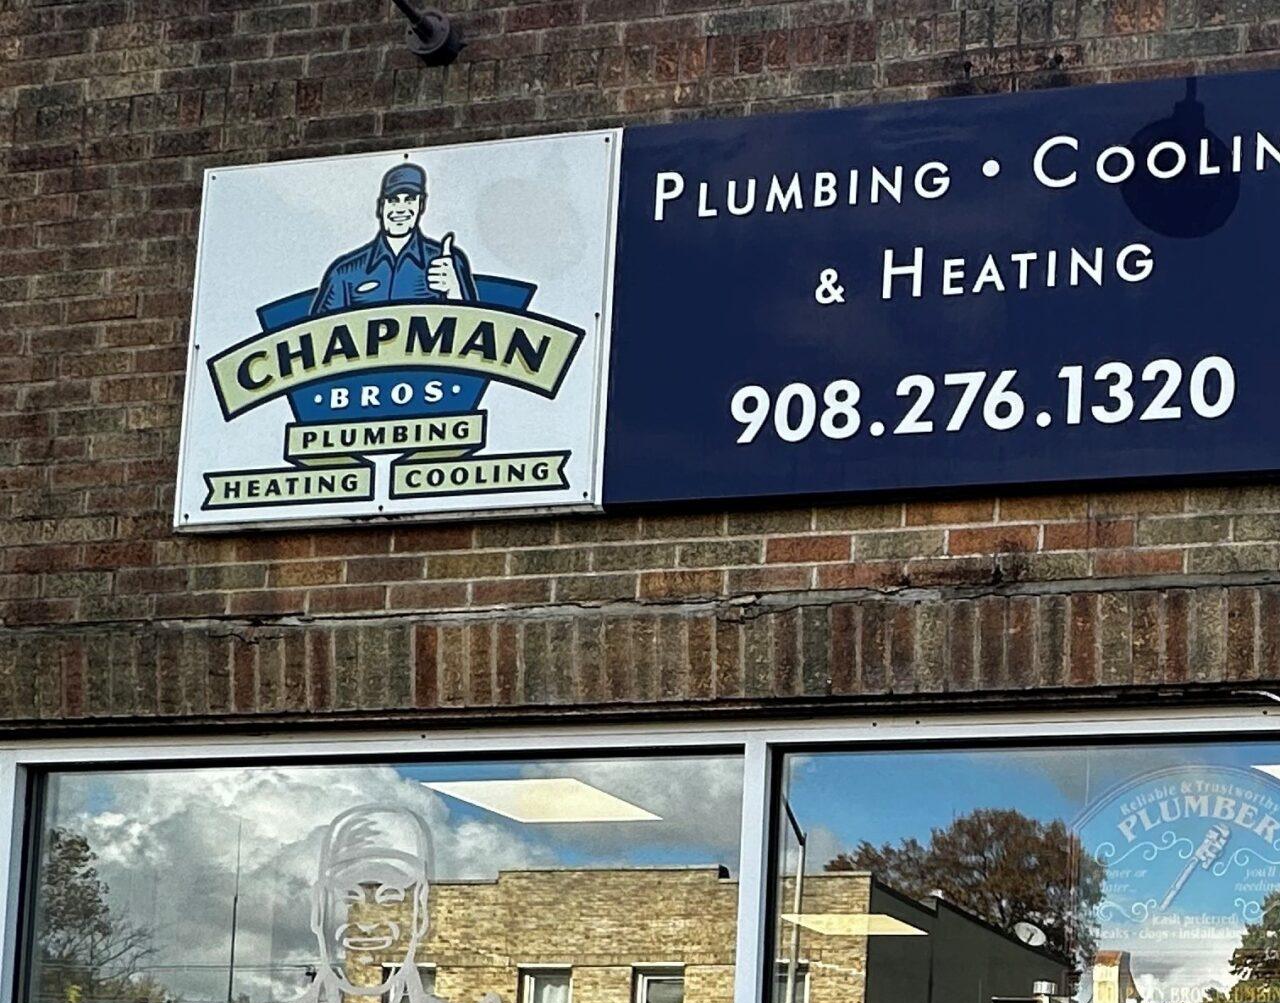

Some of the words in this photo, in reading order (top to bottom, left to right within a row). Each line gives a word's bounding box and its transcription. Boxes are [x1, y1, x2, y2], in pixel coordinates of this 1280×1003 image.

[653, 160, 951, 220] PLUMBING
[814, 268, 846, 305] &
[882, 243, 1154, 299] HEATING
[237, 315, 551, 392] CHAPMAN
[330, 381, 445, 409] BROS
[730, 355, 1236, 444] 908.276.1320
[301, 421, 471, 450] PLUMBING
[223, 473, 359, 499] HEATING
[405, 461, 550, 489] COOLING
[1180, 780, 1194, 794] &
